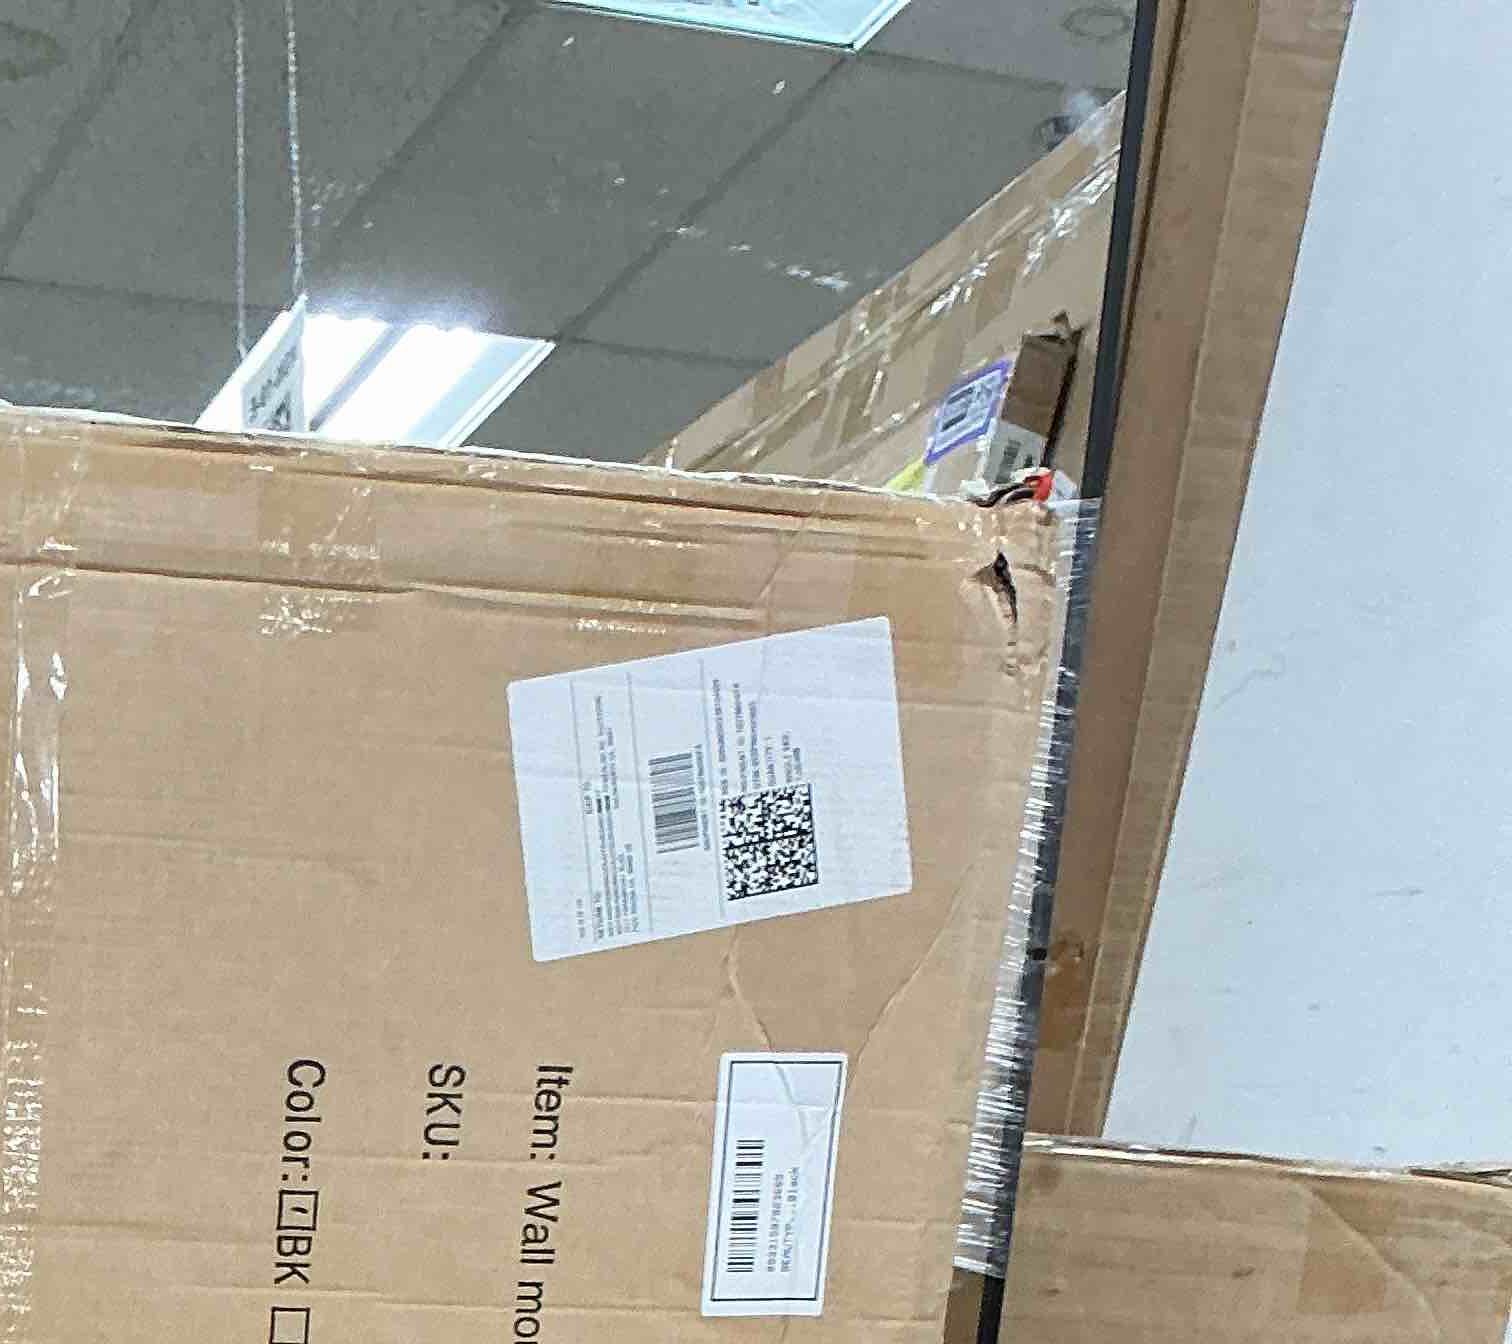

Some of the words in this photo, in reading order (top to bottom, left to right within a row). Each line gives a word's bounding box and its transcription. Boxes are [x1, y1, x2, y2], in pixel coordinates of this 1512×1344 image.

[281, 1059, 326, 1181] Color:
[422, 1063, 467, 1160] SKU:
[530, 1064, 574, 1161] Item:
[273, 1234, 313, 1285] BK
[520, 1181, 562, 1264] Wall
